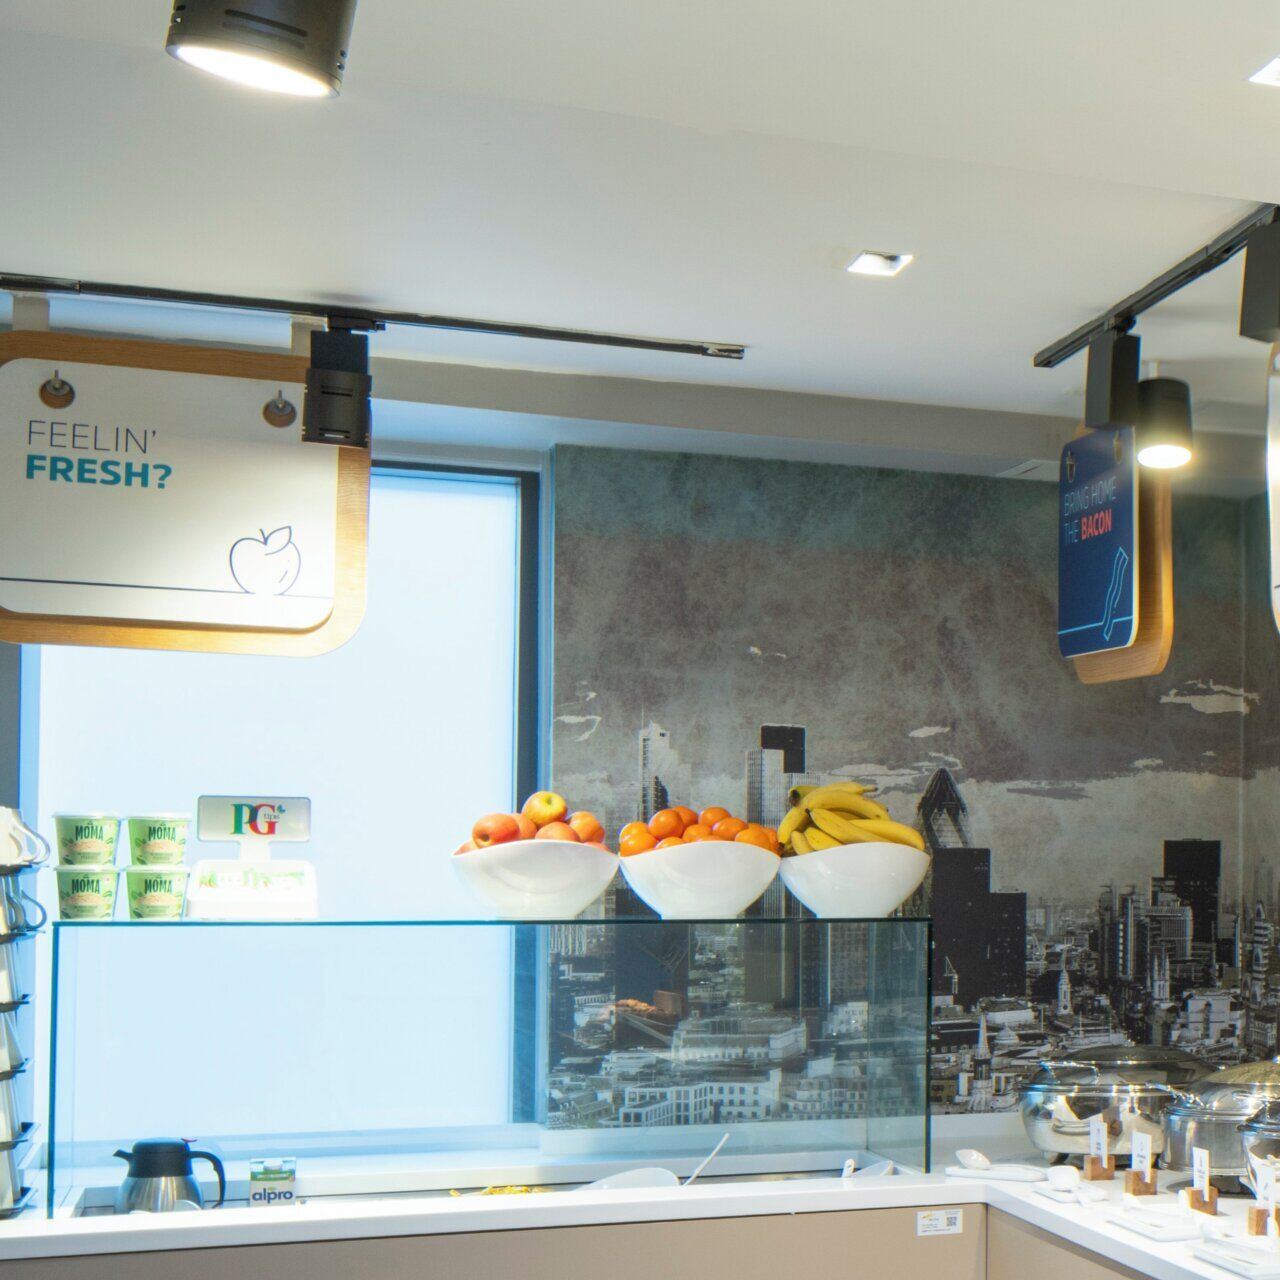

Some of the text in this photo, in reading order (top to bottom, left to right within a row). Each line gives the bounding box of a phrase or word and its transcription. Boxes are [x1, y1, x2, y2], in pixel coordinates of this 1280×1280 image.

[28, 420, 156, 454] FEELIN'
[25, 454, 173, 489] FRESH?
[1064, 476, 1117, 516] BRING HOME
[1064, 509, 1112, 544] THE BACON
[230, 803, 279, 835] PG
[252, 1188, 293, 1204] alpro
